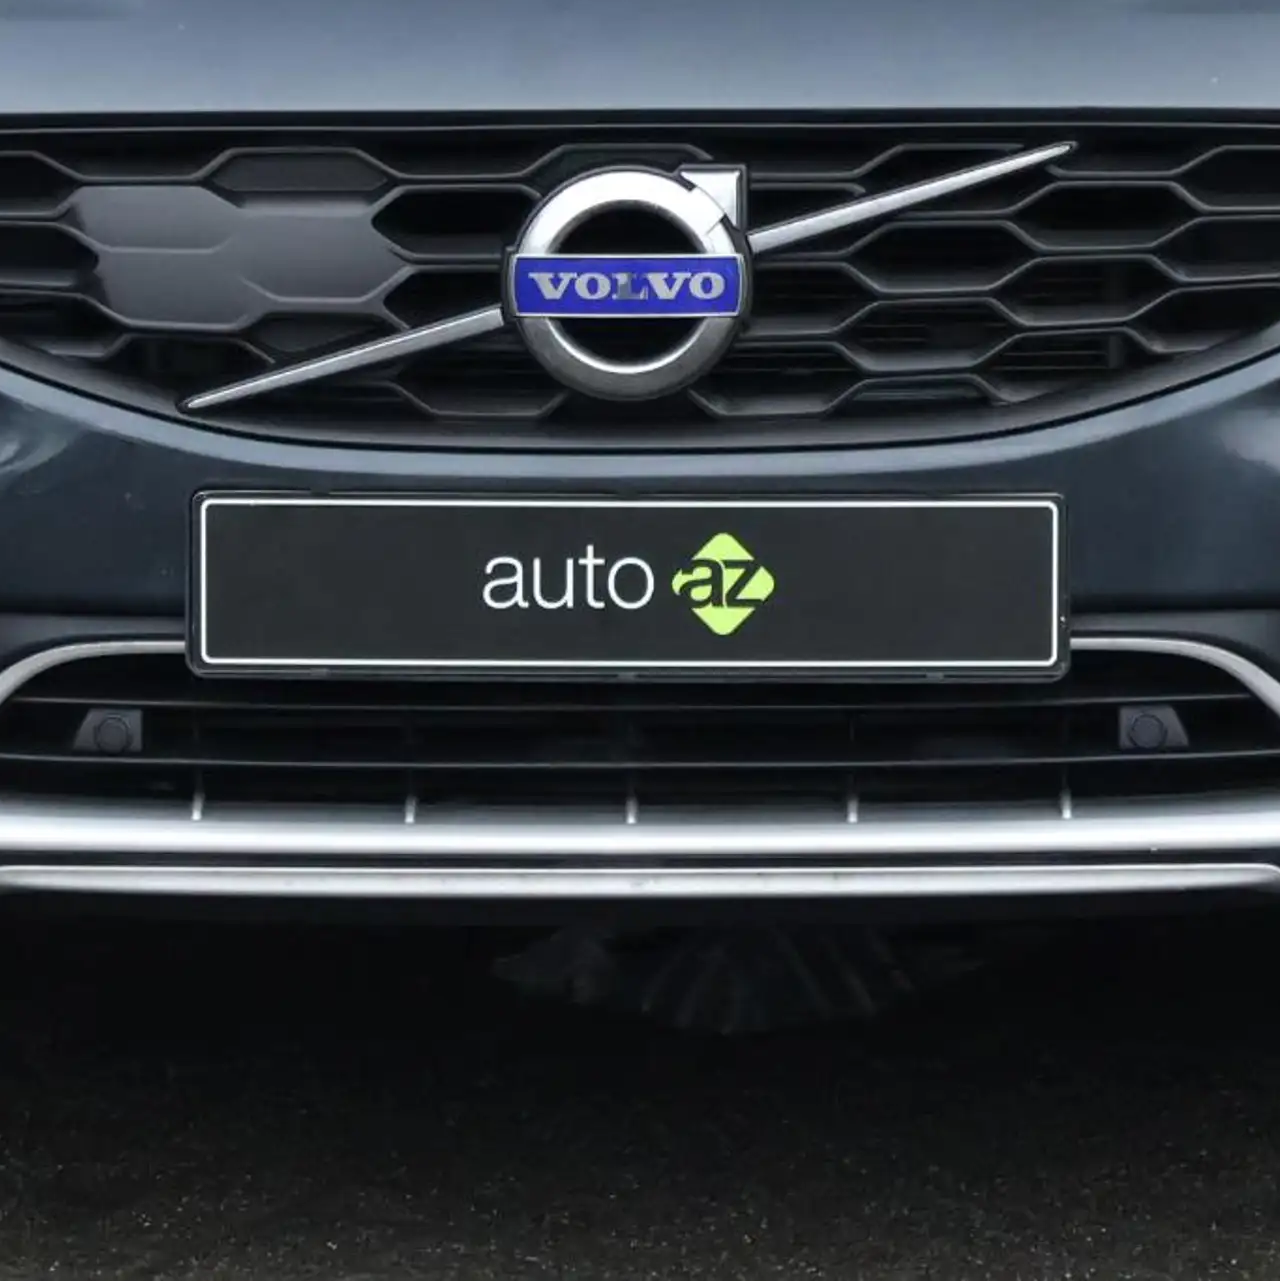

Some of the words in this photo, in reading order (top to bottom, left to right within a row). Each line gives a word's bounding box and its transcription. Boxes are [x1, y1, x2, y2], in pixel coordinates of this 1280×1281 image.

[528, 271, 726, 301] VOLVO
[482, 544, 654, 610] auto
[677, 557, 770, 609] az
